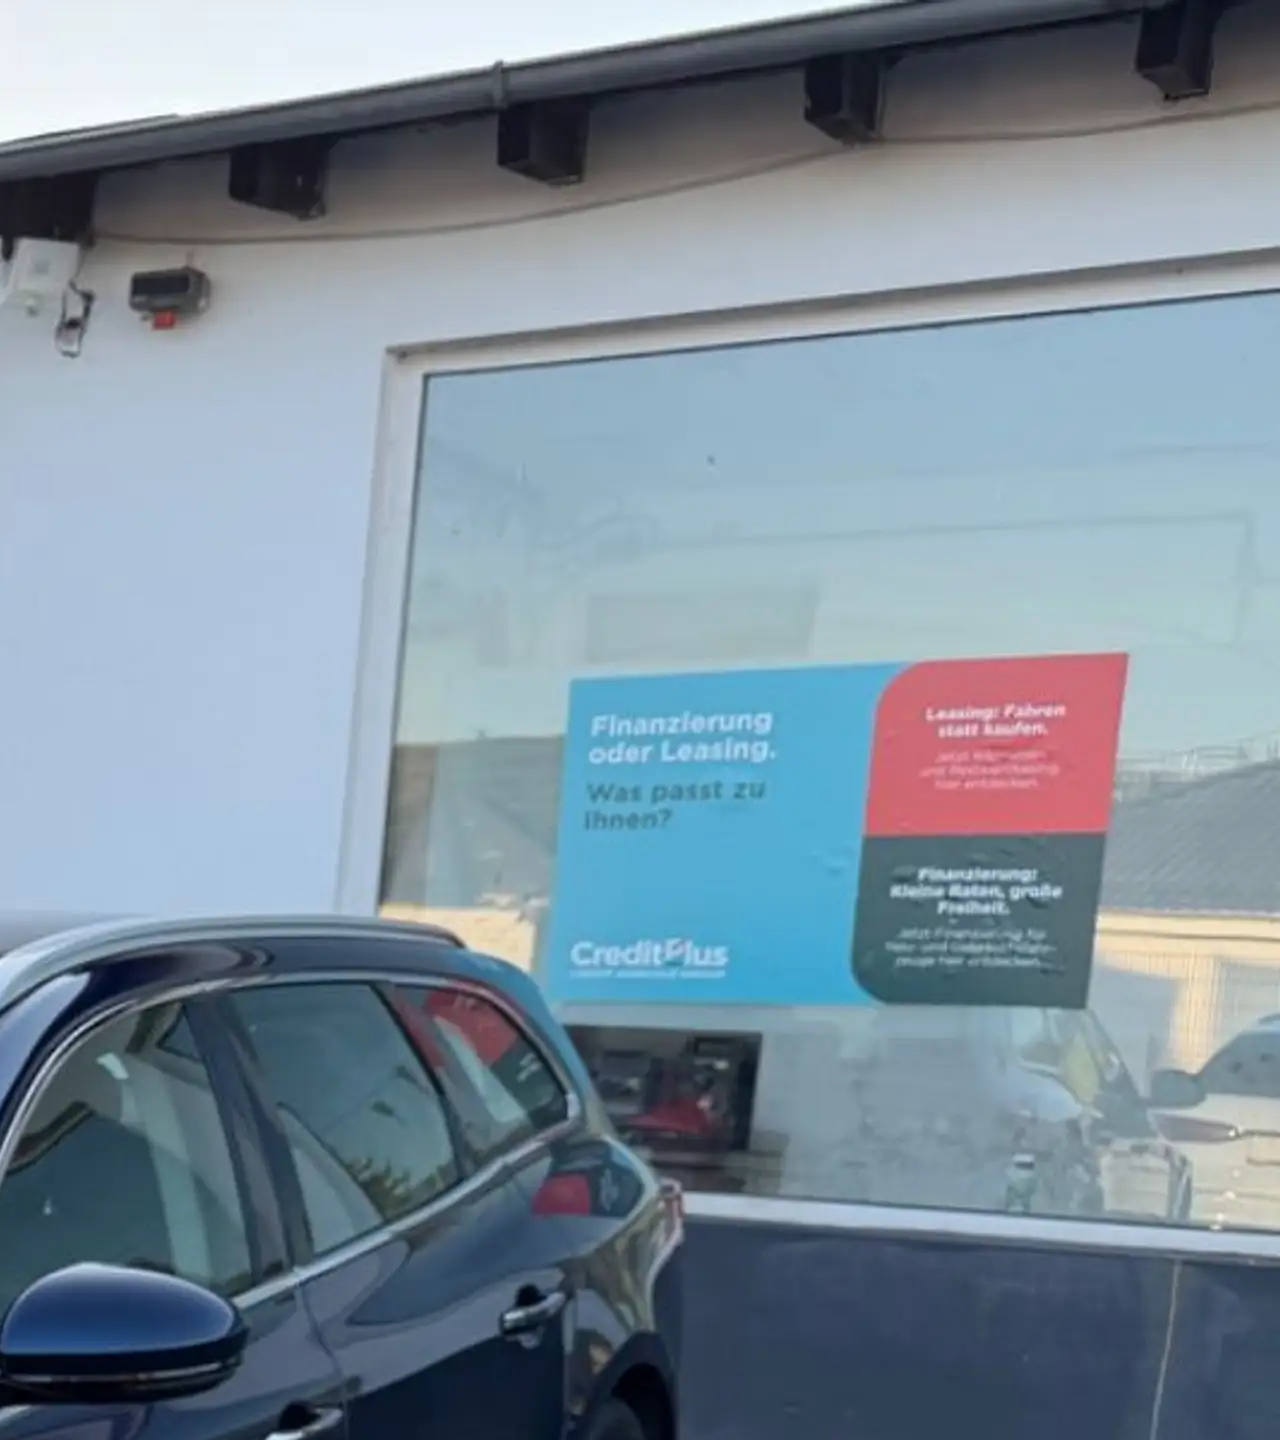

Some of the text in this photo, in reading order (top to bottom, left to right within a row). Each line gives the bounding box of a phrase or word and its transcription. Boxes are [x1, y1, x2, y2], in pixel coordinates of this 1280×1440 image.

[591, 711, 773, 737] Finanzierung
[925, 703, 1066, 722] Leasing: Fahren
[938, 721, 1048, 738] statt kaufen.
[589, 737, 777, 764] oder Leasing.
[586, 781, 766, 804] Was passt zu
[570, 938, 729, 967] CreditPlus
